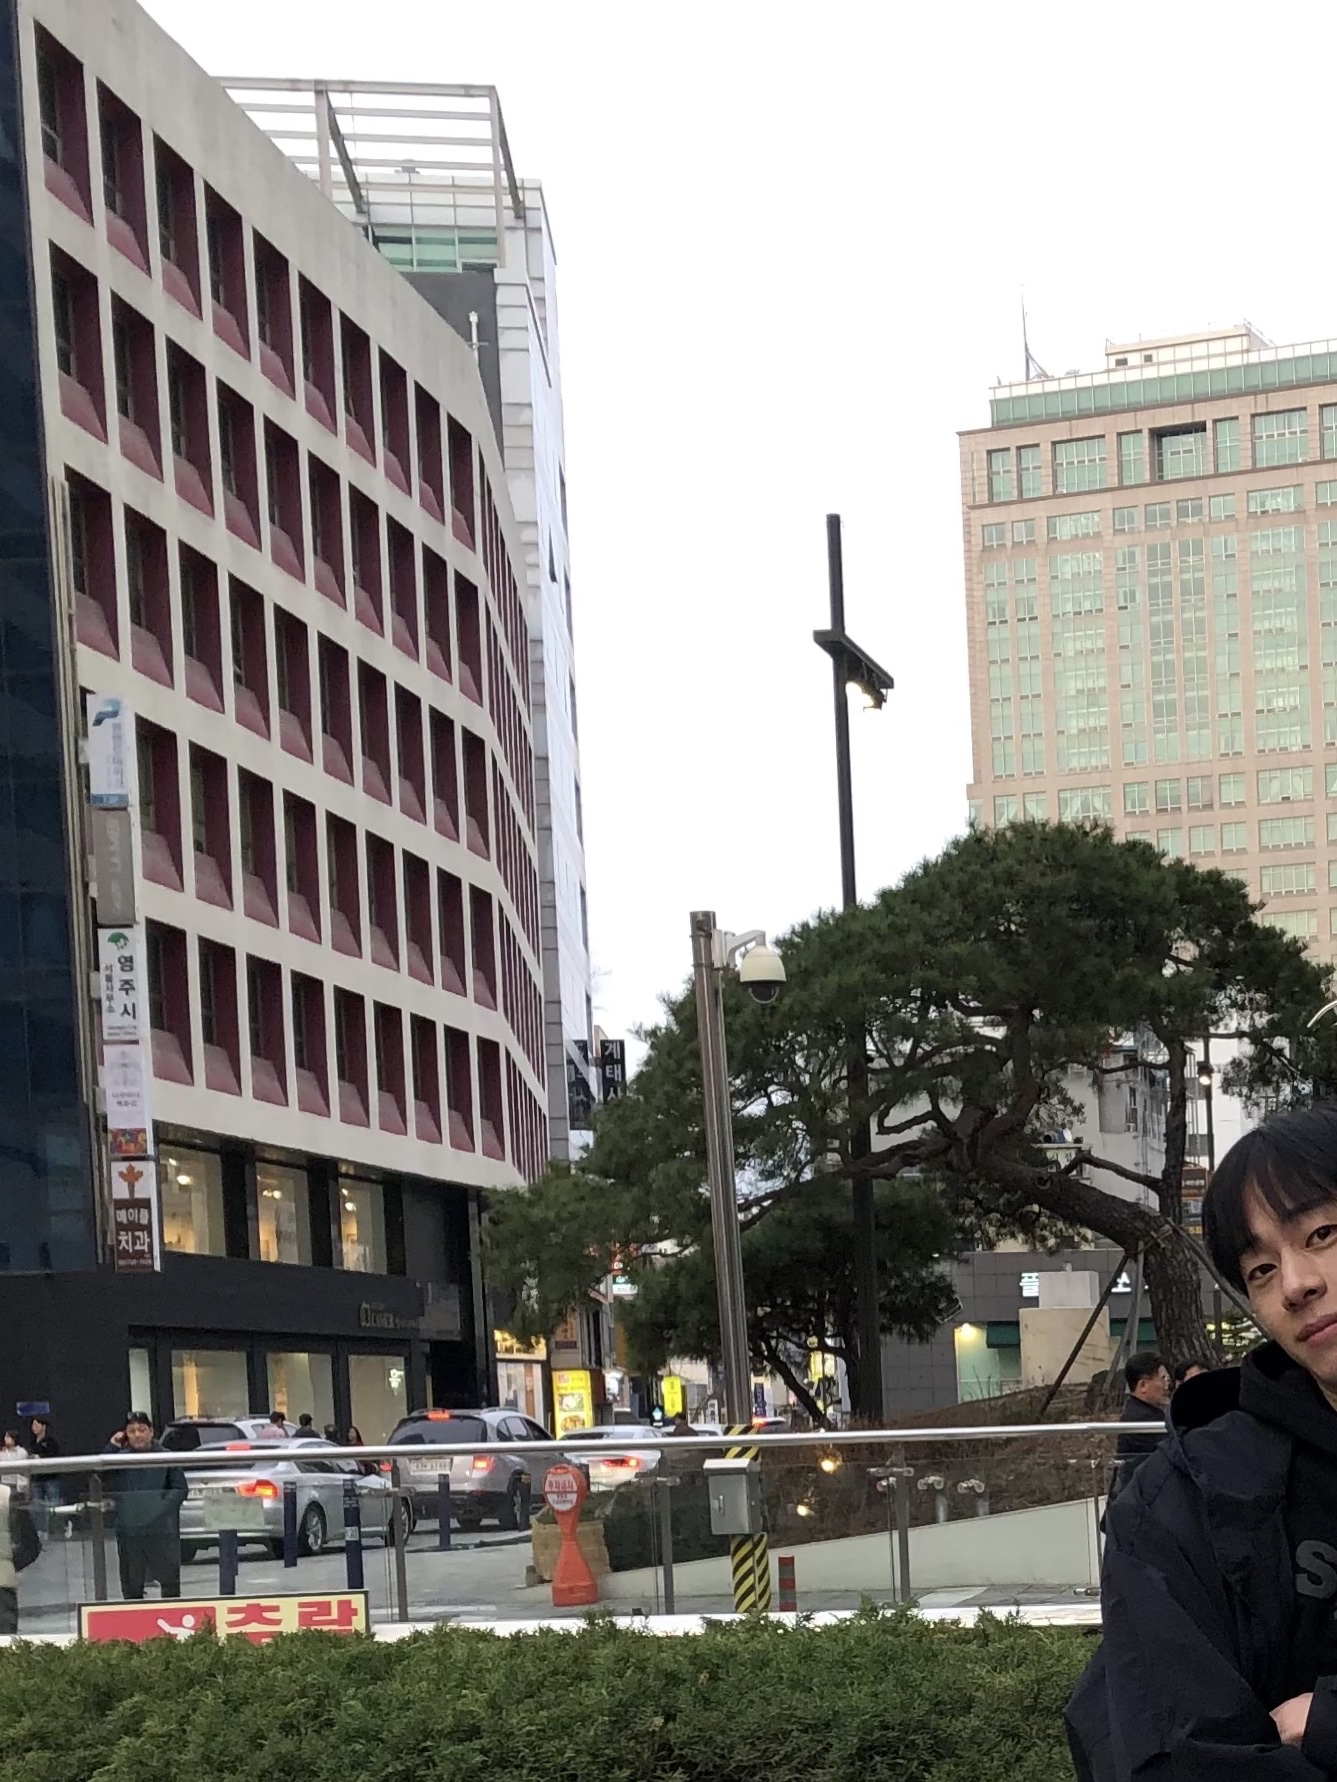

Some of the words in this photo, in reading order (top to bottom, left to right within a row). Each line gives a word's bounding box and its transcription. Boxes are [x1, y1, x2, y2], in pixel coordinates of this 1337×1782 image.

[117, 955, 136, 1020] 영주시
[115, 1207, 149, 1225] 메이플
[117, 1230, 150, 1253] 치과
